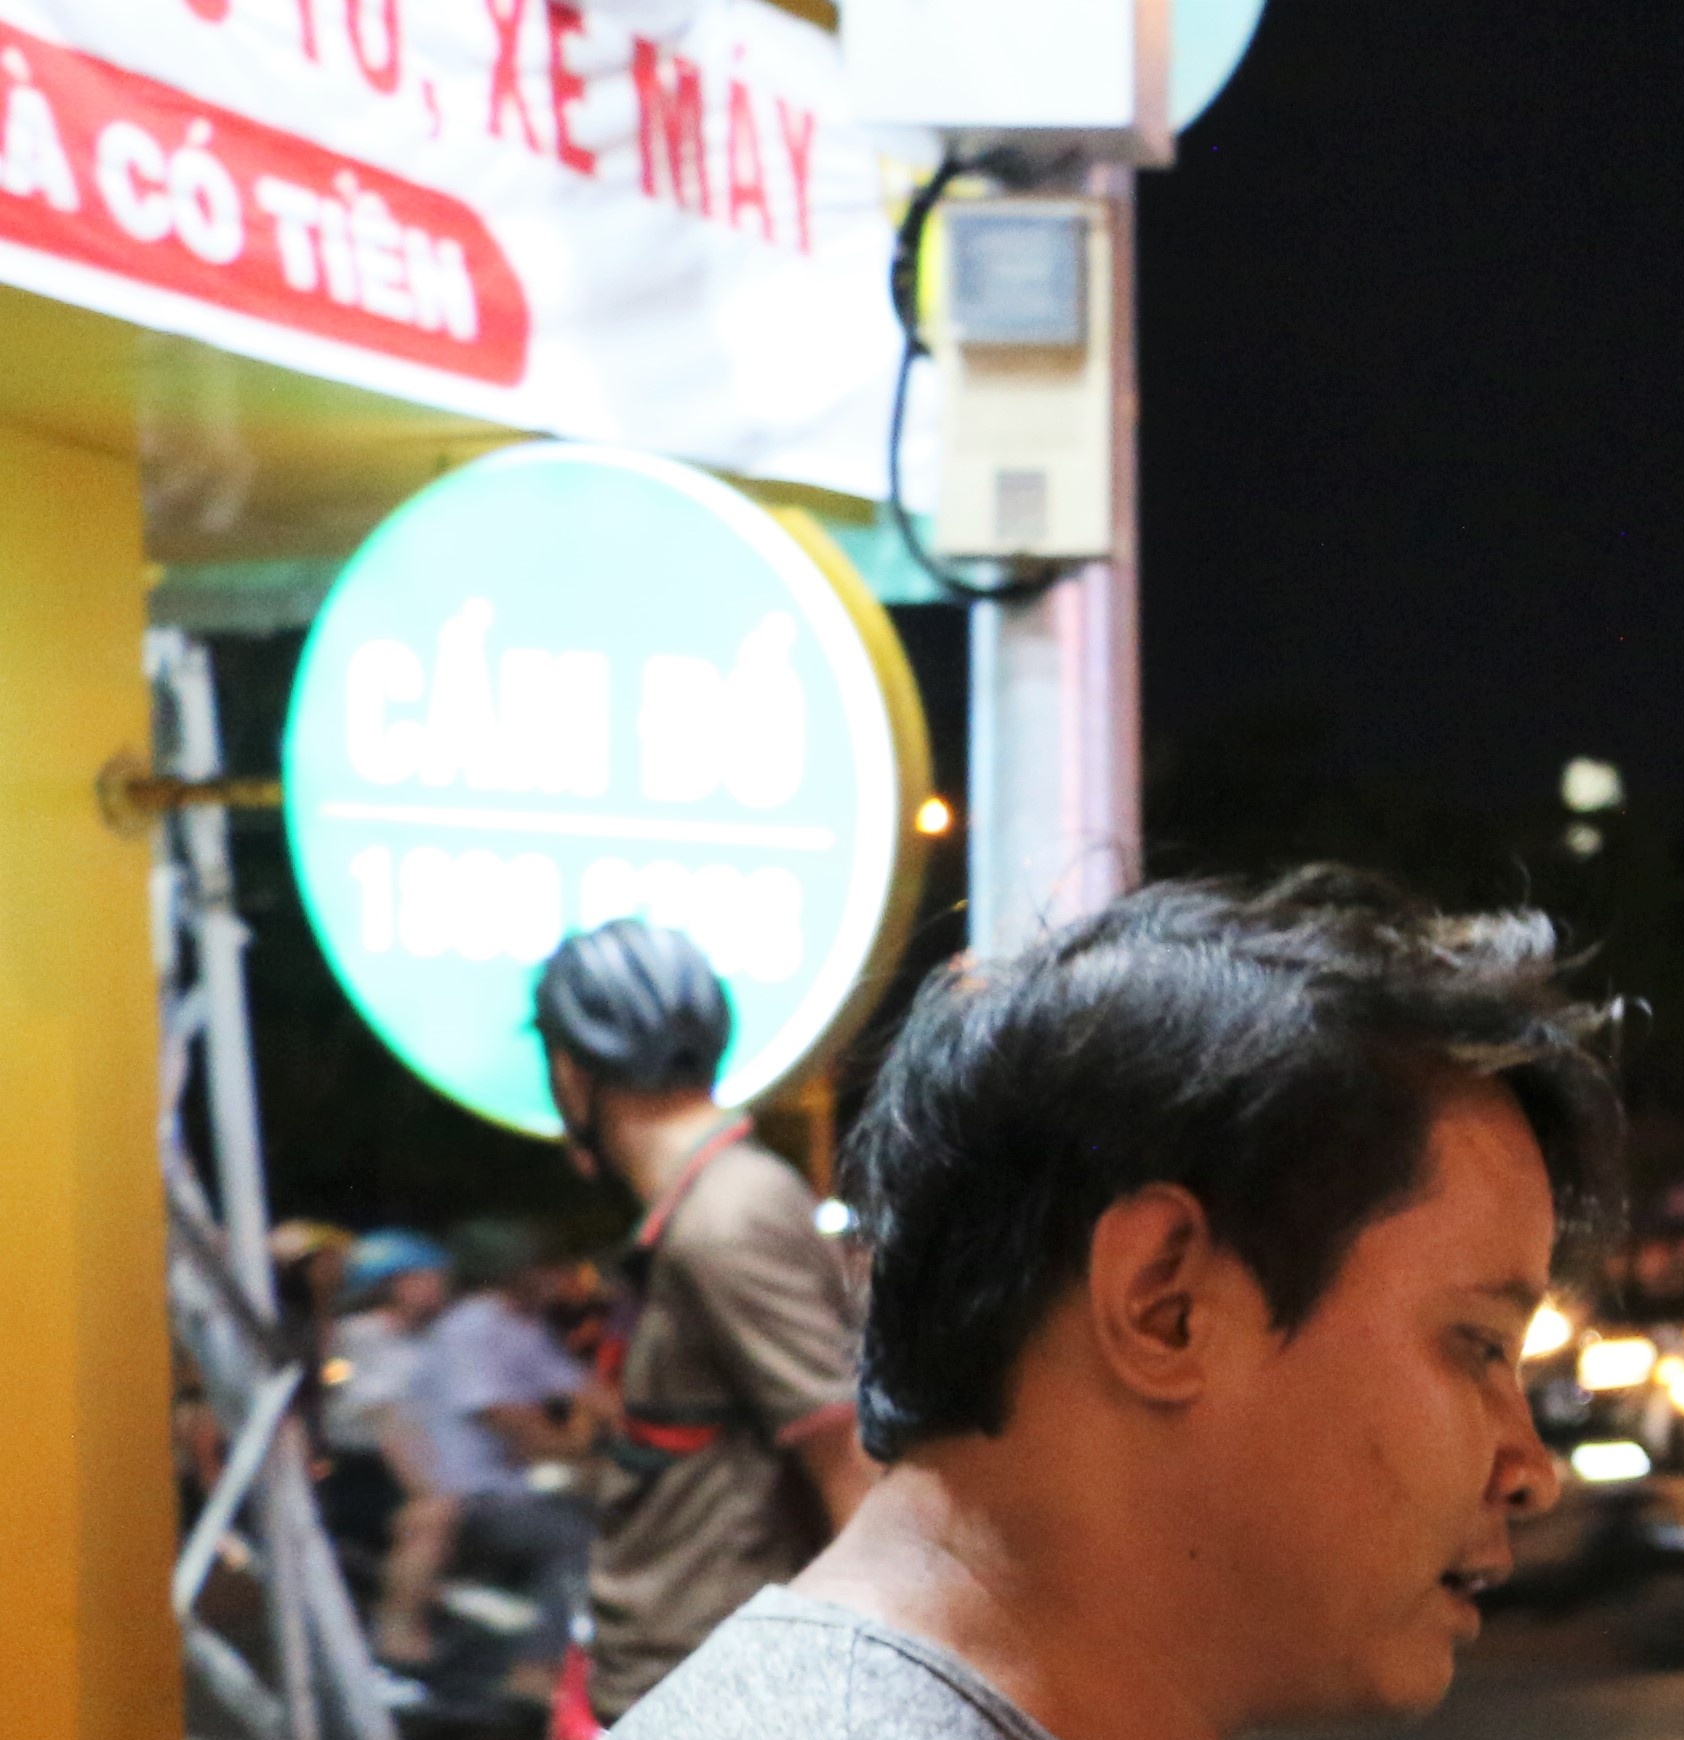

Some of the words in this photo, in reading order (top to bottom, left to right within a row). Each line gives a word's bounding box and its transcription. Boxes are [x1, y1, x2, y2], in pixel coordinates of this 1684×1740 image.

[96, 116, 246, 264] CÓ
[253, 170, 480, 345] TIỀN
[631, 32, 815, 257] MÁY
